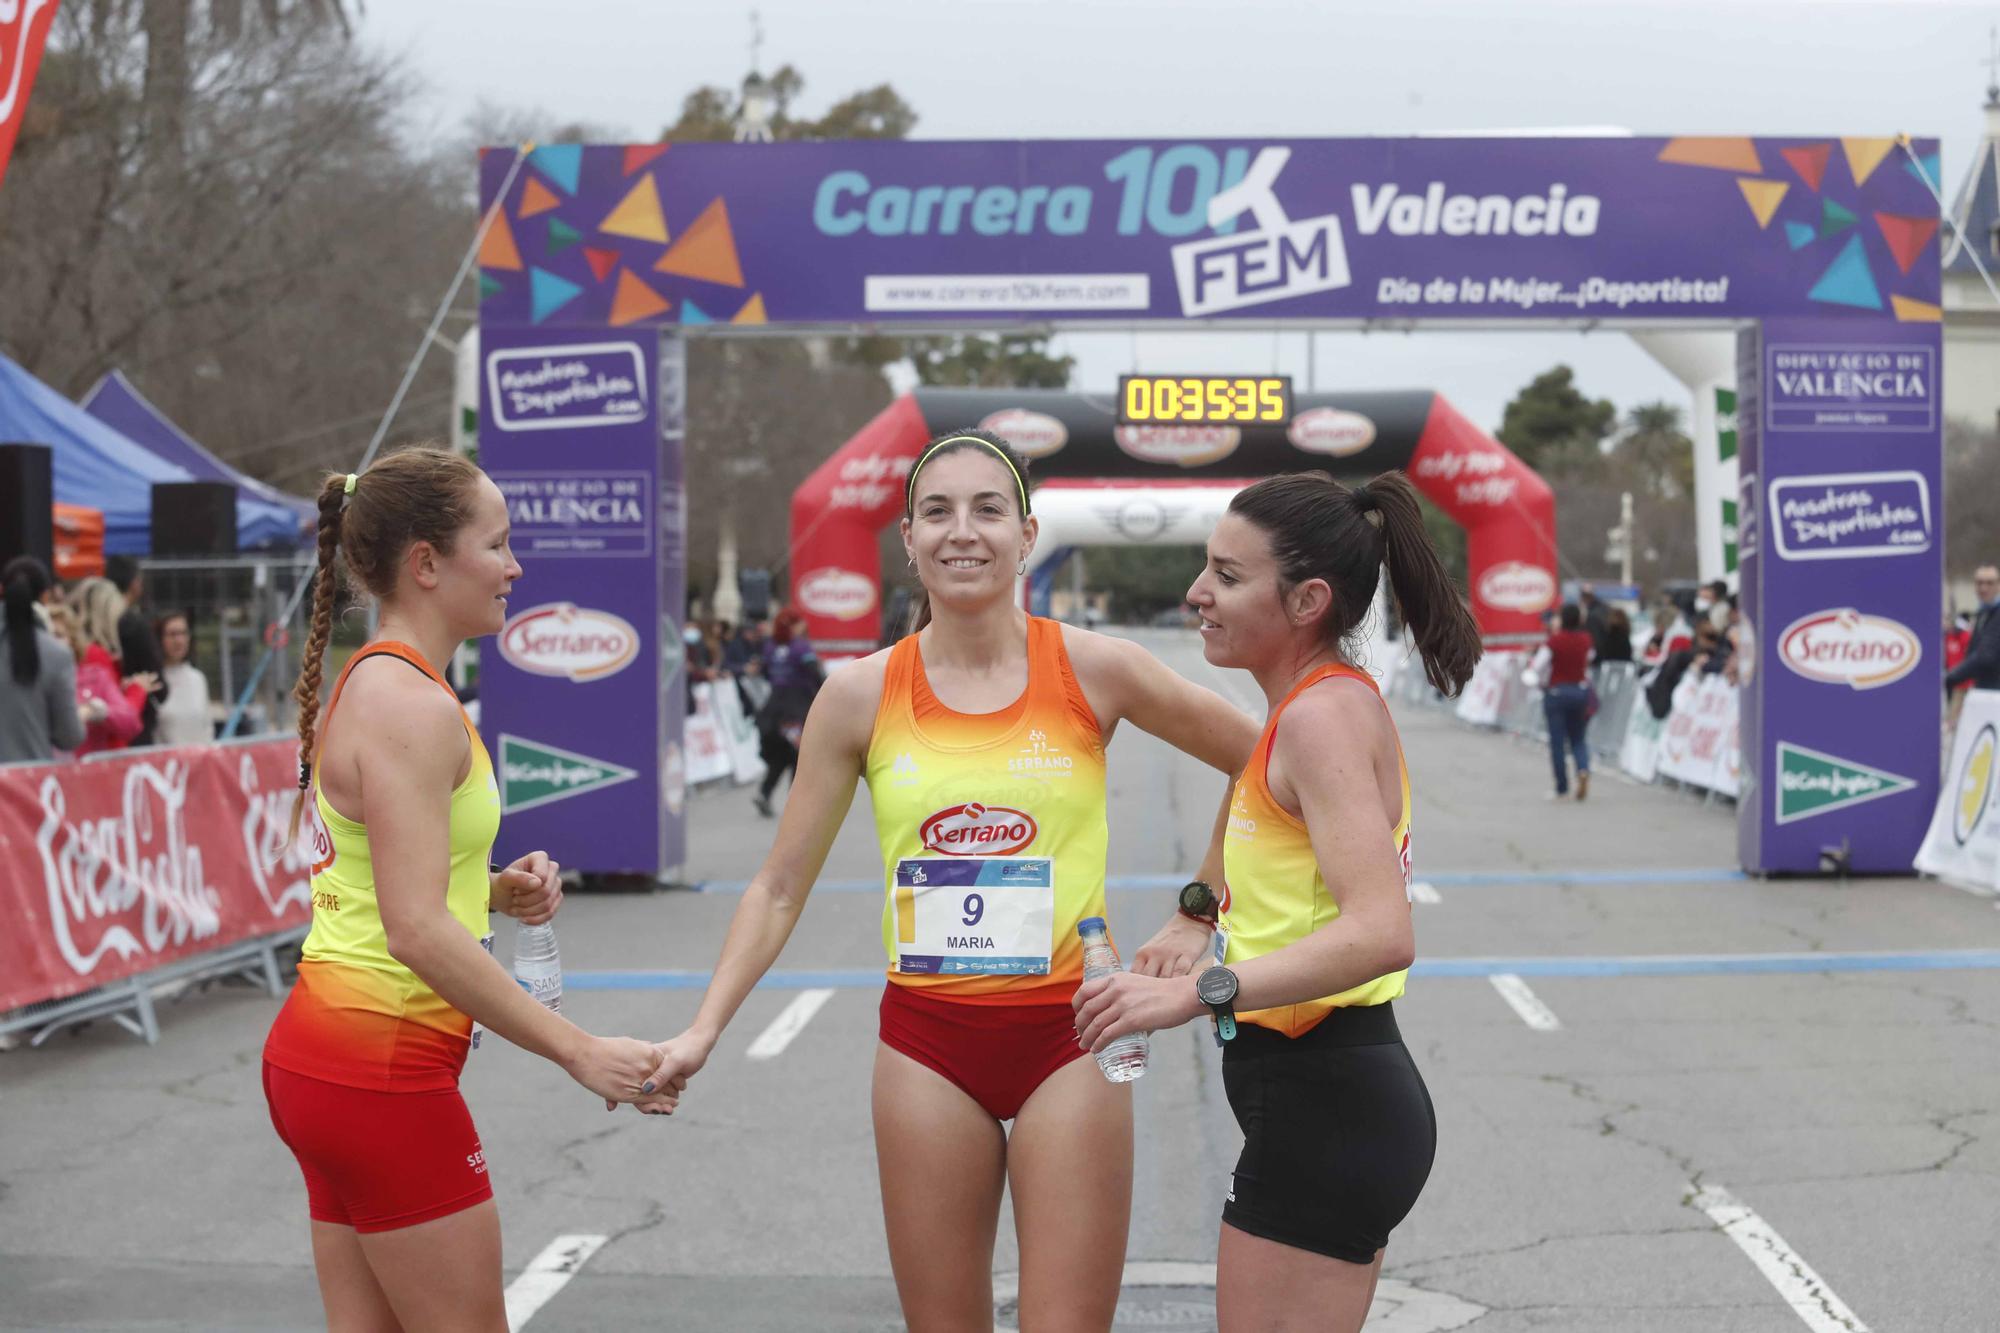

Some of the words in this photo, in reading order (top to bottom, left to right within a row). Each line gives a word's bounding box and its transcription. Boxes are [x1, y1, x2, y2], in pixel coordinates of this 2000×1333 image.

[813, 170, 1093, 236] Carrera
[1104, 144, 1292, 236] 10K
[1351, 181, 1601, 236] Valencia
[1192, 225, 1330, 306] FEM
[1424, 277, 1458, 303] de
[1460, 276, 1486, 303] la
[1896, 354, 1923, 370] DE
[1127, 379, 1283, 420] 00:35:35
[518, 624, 624, 655] Serrano
[1800, 630, 1906, 662] Serrano
[1007, 756, 1073, 771] SERRANO
[930, 822, 1027, 848] Serrano
[962, 893, 984, 926] 9
[947, 936, 995, 949] MARIA
